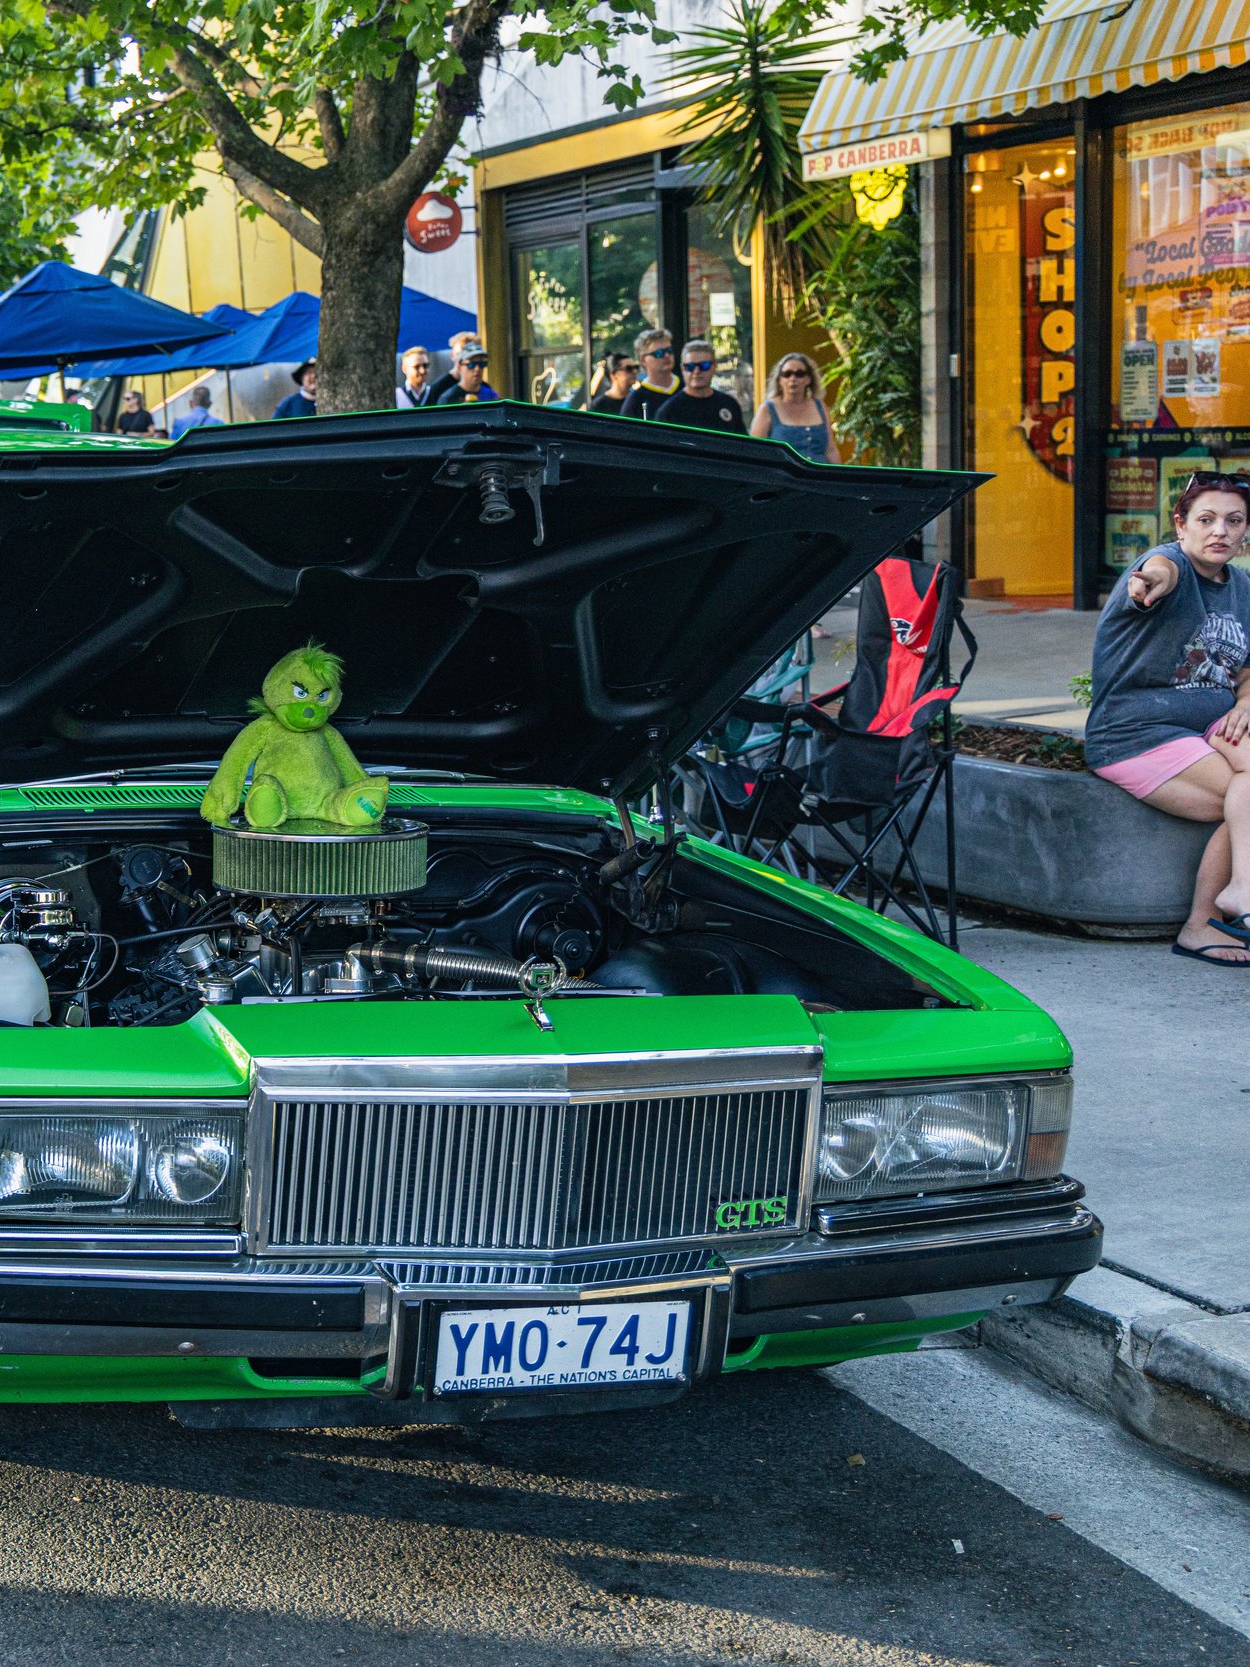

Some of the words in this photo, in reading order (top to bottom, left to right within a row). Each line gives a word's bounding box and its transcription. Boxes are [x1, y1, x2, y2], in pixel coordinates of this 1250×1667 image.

[838, 138, 922, 168] CANBERRA
[1142, 266, 1193, 292] Local
[1123, 354, 1155, 367] OPEN
[716, 1196, 787, 1227] GTS
[442, 1376, 515, 1391] CANBERRA
[529, 1373, 555, 1385] THE
[559, 1368, 617, 1383] NATION'S
[622, 1367, 674, 1379] CAPITAL
